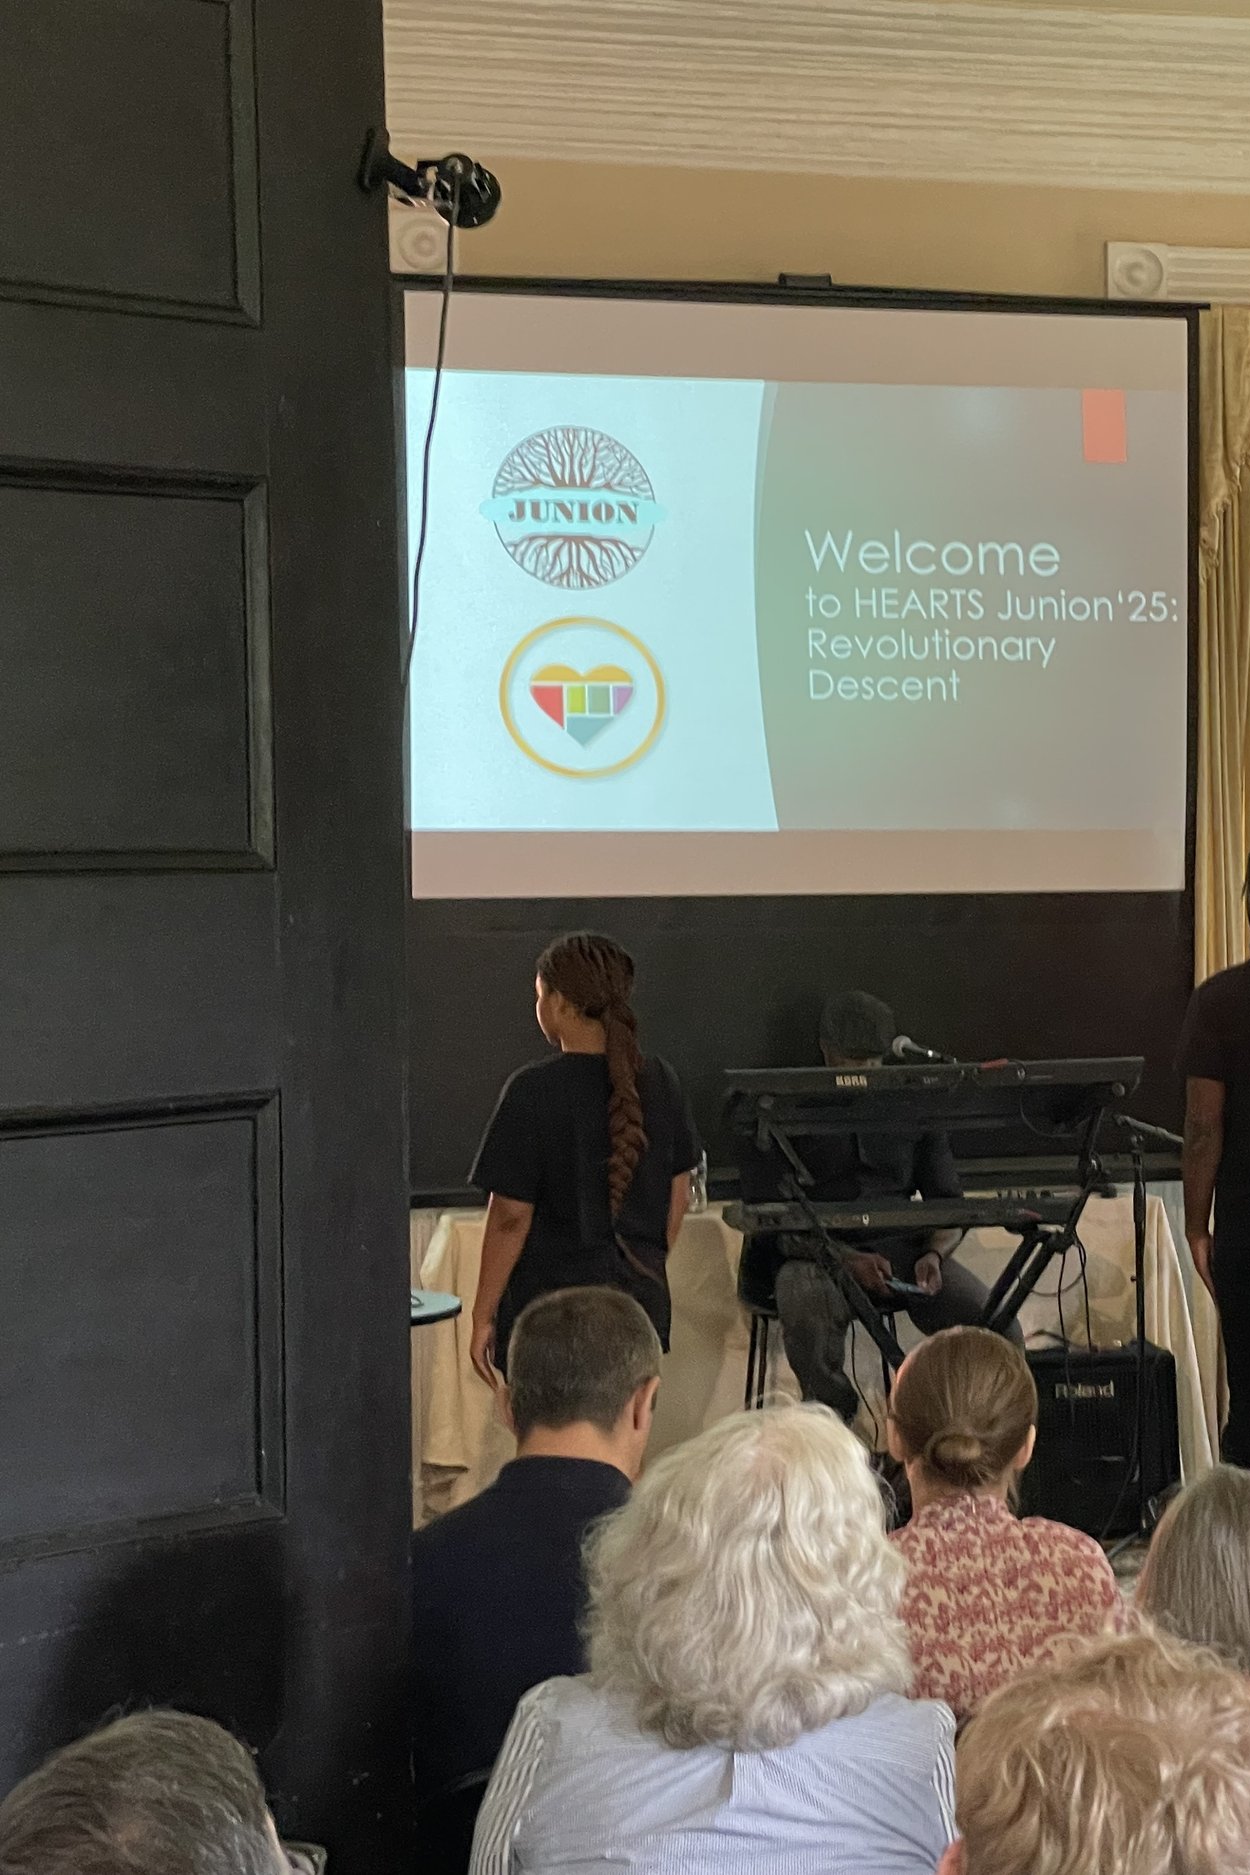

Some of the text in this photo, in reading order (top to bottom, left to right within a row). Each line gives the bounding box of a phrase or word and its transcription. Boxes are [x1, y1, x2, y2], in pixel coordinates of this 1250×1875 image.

[508, 499, 640, 524] JUNION
[804, 527, 1061, 577] Welcome
[804, 585, 842, 619] to
[854, 586, 985, 620] HEARTS
[807, 627, 1056, 669] Revolutionary
[808, 667, 961, 702] Descent
[1054, 1379, 1115, 1399] Roland
